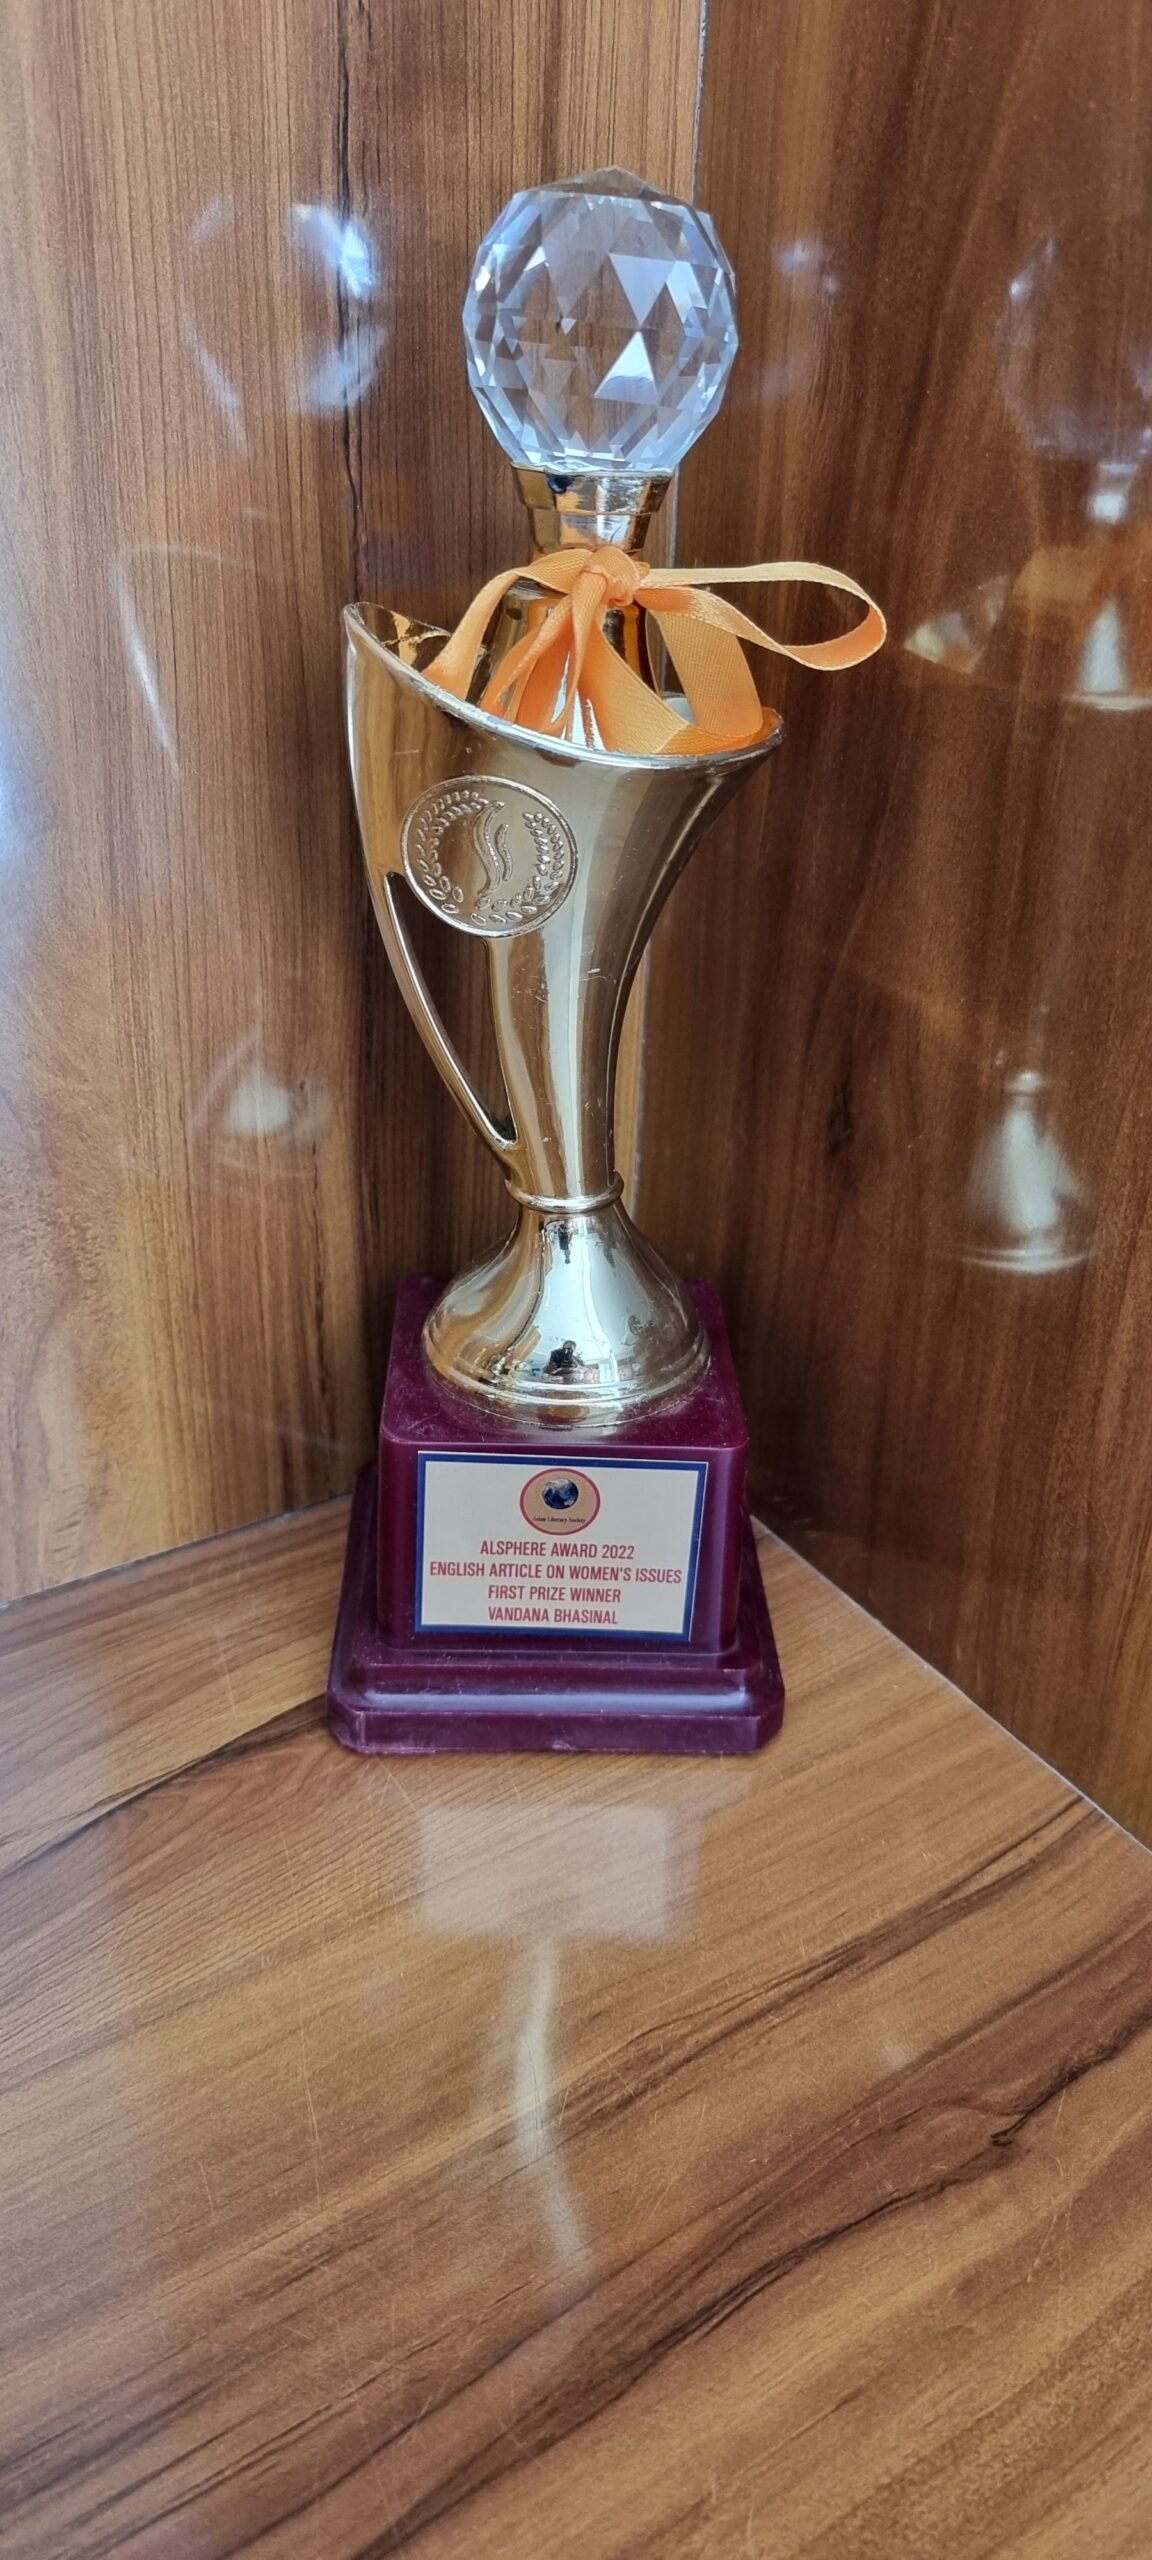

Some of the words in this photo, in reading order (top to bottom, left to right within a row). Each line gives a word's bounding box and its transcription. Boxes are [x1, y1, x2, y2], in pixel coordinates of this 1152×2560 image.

[480, 1540, 546, 1557] ALSPHERE
[551, 1542, 597, 1558] AWARD
[602, 1544, 635, 1560] 2022
[430, 1561, 485, 1577] ENGLISH
[489, 1563, 542, 1578] ARTICLE
[546, 1565, 564, 1579] ON
[569, 1565, 631, 1582] WOMEN'S
[635, 1568, 682, 1584] ISSUES
[488, 1585, 525, 1600] FIRST
[529, 1586, 566, 1601] PRIZE
[570, 1587, 622, 1603] WINNER
[488, 1606, 549, 1622] VANDANA
[553, 1608, 619, 1624] BHASINAL
